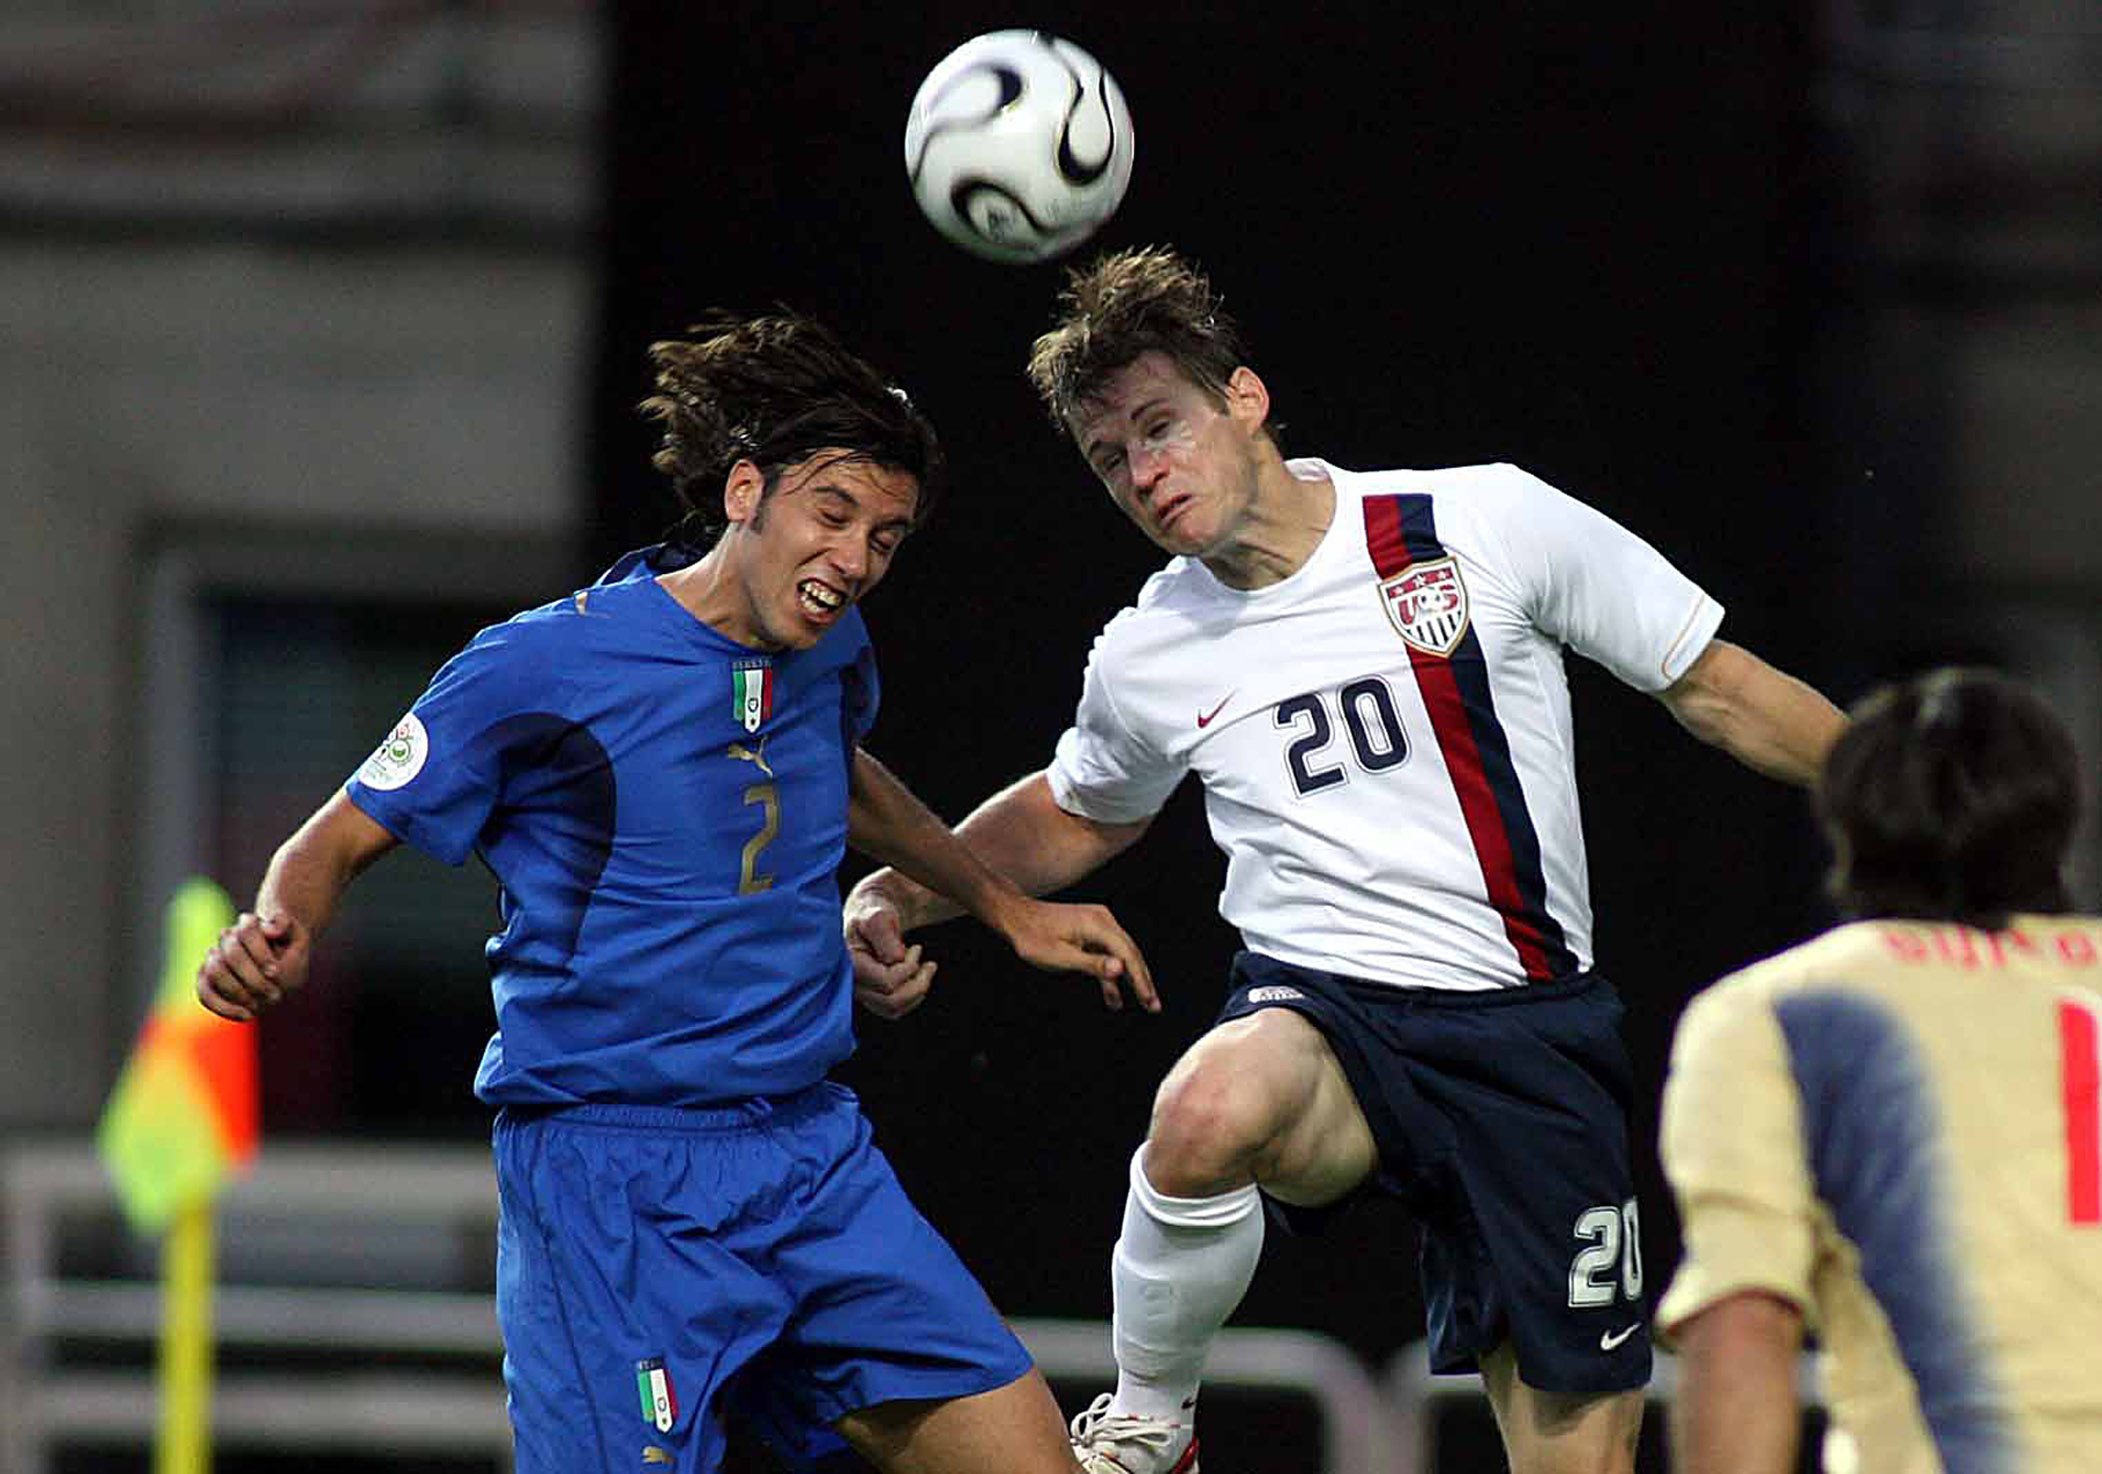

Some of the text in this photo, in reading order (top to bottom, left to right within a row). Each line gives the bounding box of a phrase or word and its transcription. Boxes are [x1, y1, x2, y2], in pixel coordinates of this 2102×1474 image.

[1273, 675, 1411, 798] 20
[739, 785, 780, 895] 2
[2057, 1001, 2100, 1224] 1
[1568, 1197, 1643, 1308] 20
